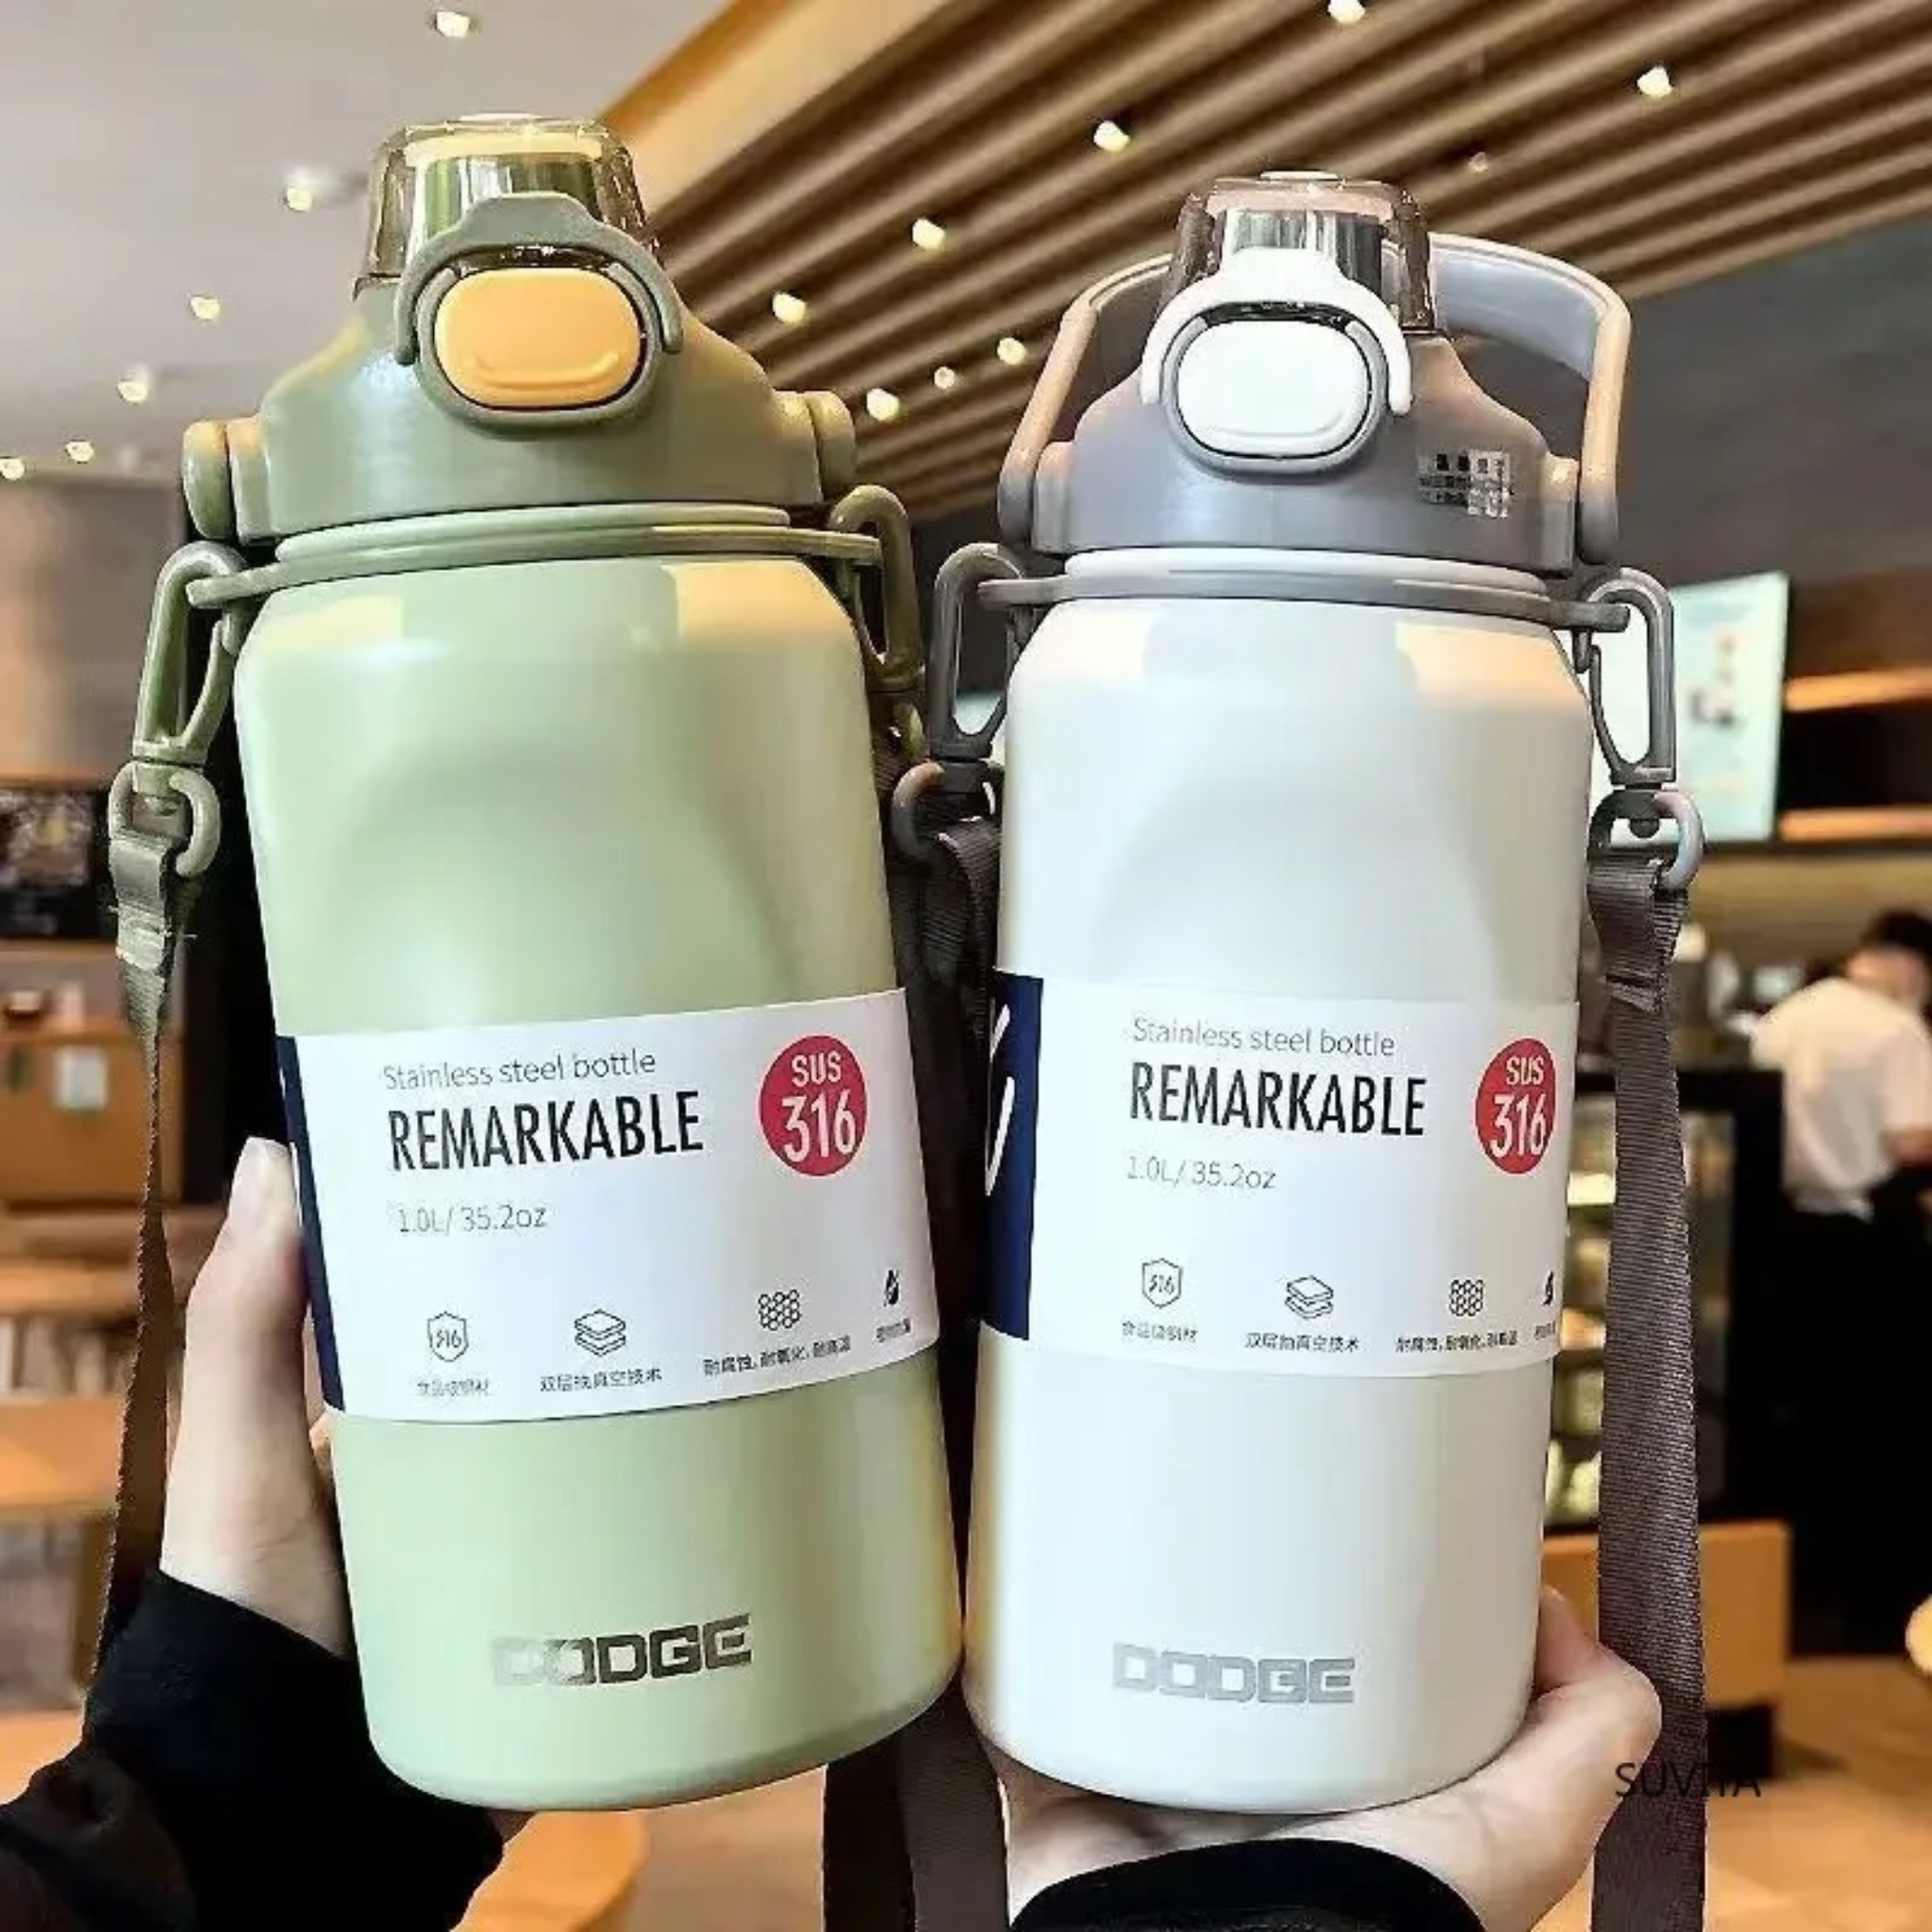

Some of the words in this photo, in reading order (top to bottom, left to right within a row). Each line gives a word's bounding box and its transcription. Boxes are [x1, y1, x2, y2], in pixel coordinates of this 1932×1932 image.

[1133, 1018, 1242, 1049] Stainless
[1250, 1029, 1311, 1053] steel
[1319, 1029, 1395, 1056] bottle
[383, 1061, 493, 1090] Stainless
[499, 1054, 564, 1083] steel
[573, 1048, 655, 1078] bottle
[791, 1050, 841, 1087] SUS
[1506, 1054, 1544, 1085] SUS
[1130, 1061, 1428, 1136] REMARKABLE
[388, 1090, 703, 1171] REMARKABLE
[781, 1089, 856, 1163] 316
[1490, 1093, 1547, 1159] 316
[1191, 1161, 1276, 1189] 35.2oz
[462, 1204, 547, 1232] 35.2oz
[492, 1613, 752, 1686] DODGE
[1113, 1641, 1355, 1703] DODGE
